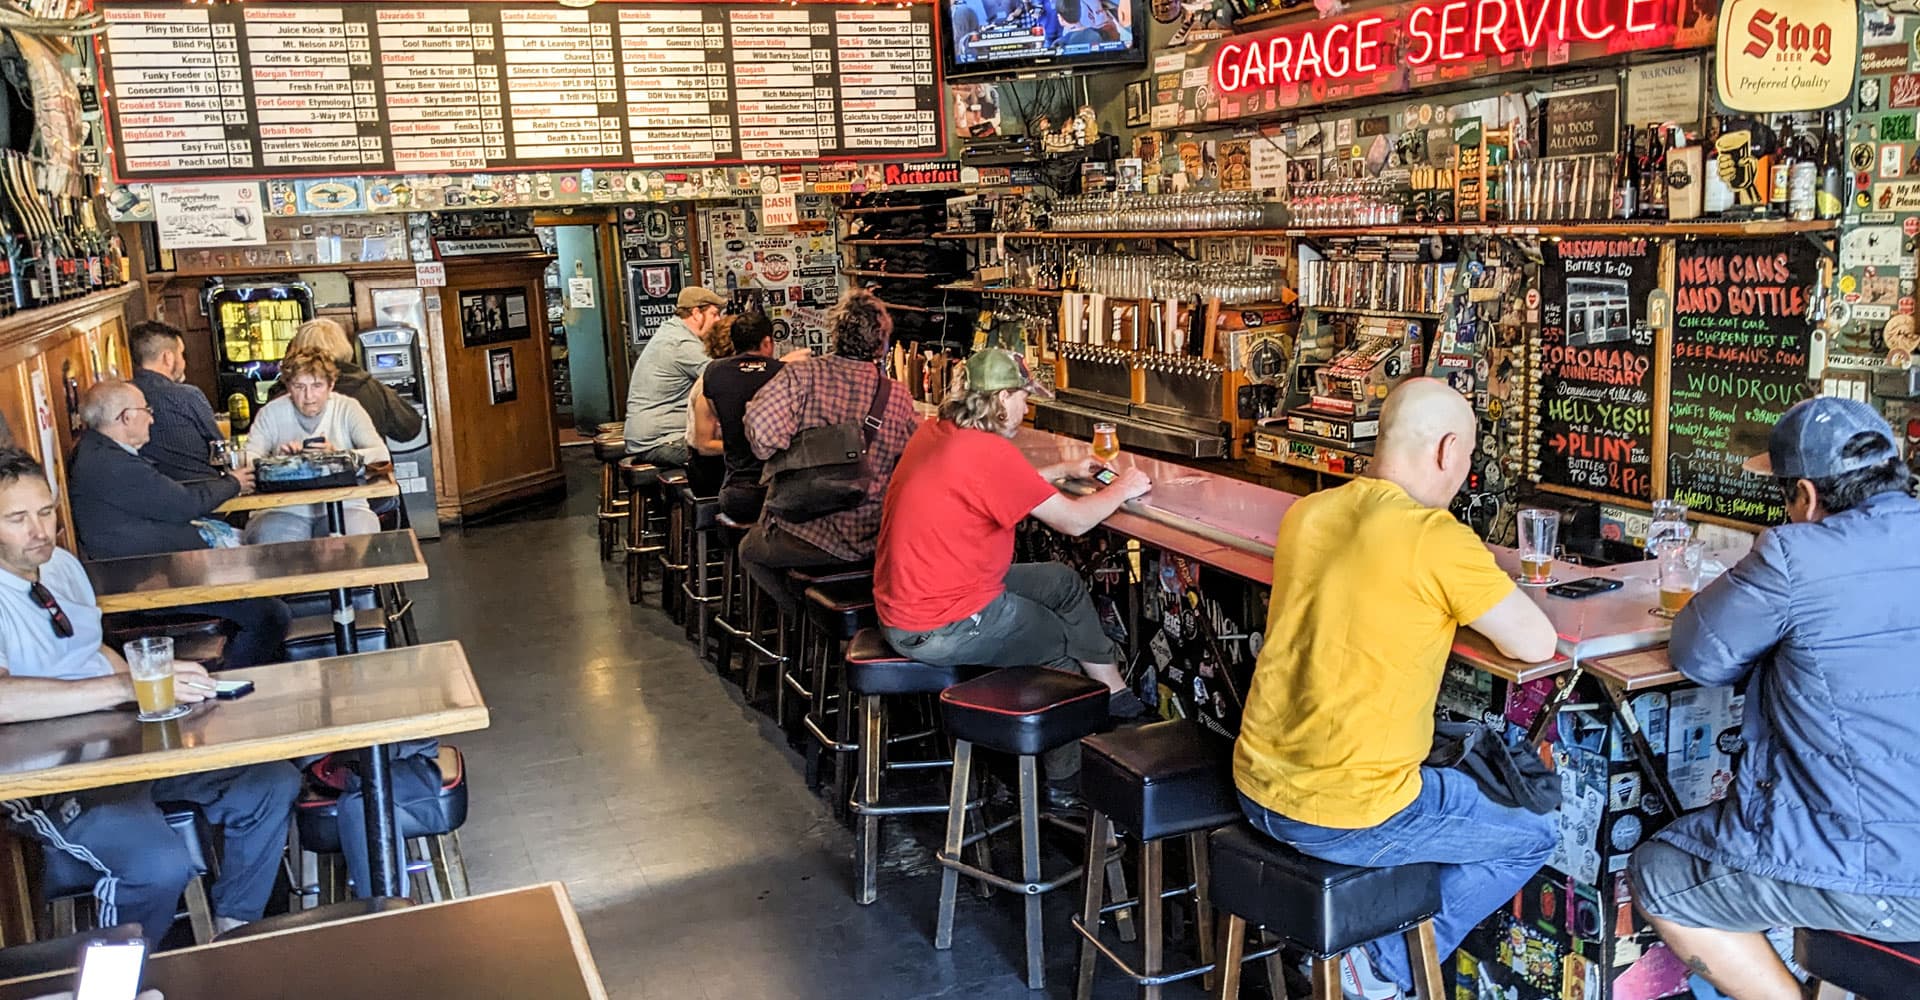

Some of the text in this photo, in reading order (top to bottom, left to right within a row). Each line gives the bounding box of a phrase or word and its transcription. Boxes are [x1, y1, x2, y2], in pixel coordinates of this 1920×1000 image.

[105, 11, 166, 19] Russian River
[245, 11, 296, 19] Cellarmaker
[145, 26, 165, 34] Pliny
[183, 25, 208, 33] Elder
[215, 26, 226, 34] $7
[302, 26, 324, 34] Kiosk
[648, 26, 665, 34] Song
[677, 25, 701, 33] Silence
[1743, 8, 1832, 65] Stag
[173, 40, 227, 50] Blind Pig $6
[549, 40, 576, 48] Leaving
[1218, 0, 1656, 91] GARAGE SERVICE
[182, 56, 229, 64] Kernza $7
[265, 55, 346, 64] Coffee & Cigarettes
[1776, 52, 1802, 62] BEER
[143, 70, 231, 80] Funky Foeder (s) $7
[255, 69, 323, 79] Morgan Territory
[1640, 66, 1686, 80] WARNING
[289, 83, 312, 91] Fresh
[314, 83, 334, 91] Fruit
[396, 81, 414, 91] Keep
[439, 81, 460, 89] Weird
[1739, 75, 1830, 94] Preferred Quality
[128, 86, 184, 95] Consecration
[205, 85, 216, 94] (s)
[222, 85, 232, 93] $7
[122, 114, 237, 124] Heater Allen Pils $7
[874, 113, 879, 121] by
[881, 113, 902, 121] Clipper
[1553, 120, 1594, 134] NO DOGS
[263, 140, 356, 149] Travelers Welcome APA
[1551, 135, 1598, 148] ALLOWED
[182, 142, 242, 152] Easy Fruit $6
[395, 151, 415, 159] There
[417, 150, 435, 158] Does
[454, 149, 475, 157] Exist
[130, 157, 226, 168] Temescal Peach Loot
[450, 159, 466, 168] Stag
[885, 164, 958, 185] Rochefort
[1896, 185, 1909, 195] My
[764, 198, 792, 208] CASH
[766, 213, 793, 224] ONLY
[1558, 240, 1607, 258] RUSSIAN
[418, 266, 442, 274] CASH
[1680, 253, 1790, 285] NEW CANS
[420, 277, 443, 286] ONLY
[1676, 286, 1722, 314] AND
[1679, 316, 1715, 328] CHECK
[1719, 318, 1738, 328] OUT
[1696, 330, 1796, 346] CURRENT LIST AT
[1542, 344, 1649, 372] TORONADO
[1559, 364, 1645, 386] ANNIVERSARY
[1688, 372, 1806, 405] WONDROUS
[1549, 399, 1594, 423] HELL
[1597, 404, 1650, 435] YES!!
[1569, 424, 1631, 440] WE HAVE
[1568, 432, 1637, 464] PLINY
[1568, 457, 1606, 472] BOTTLES
[1570, 470, 1608, 486] TO GO
